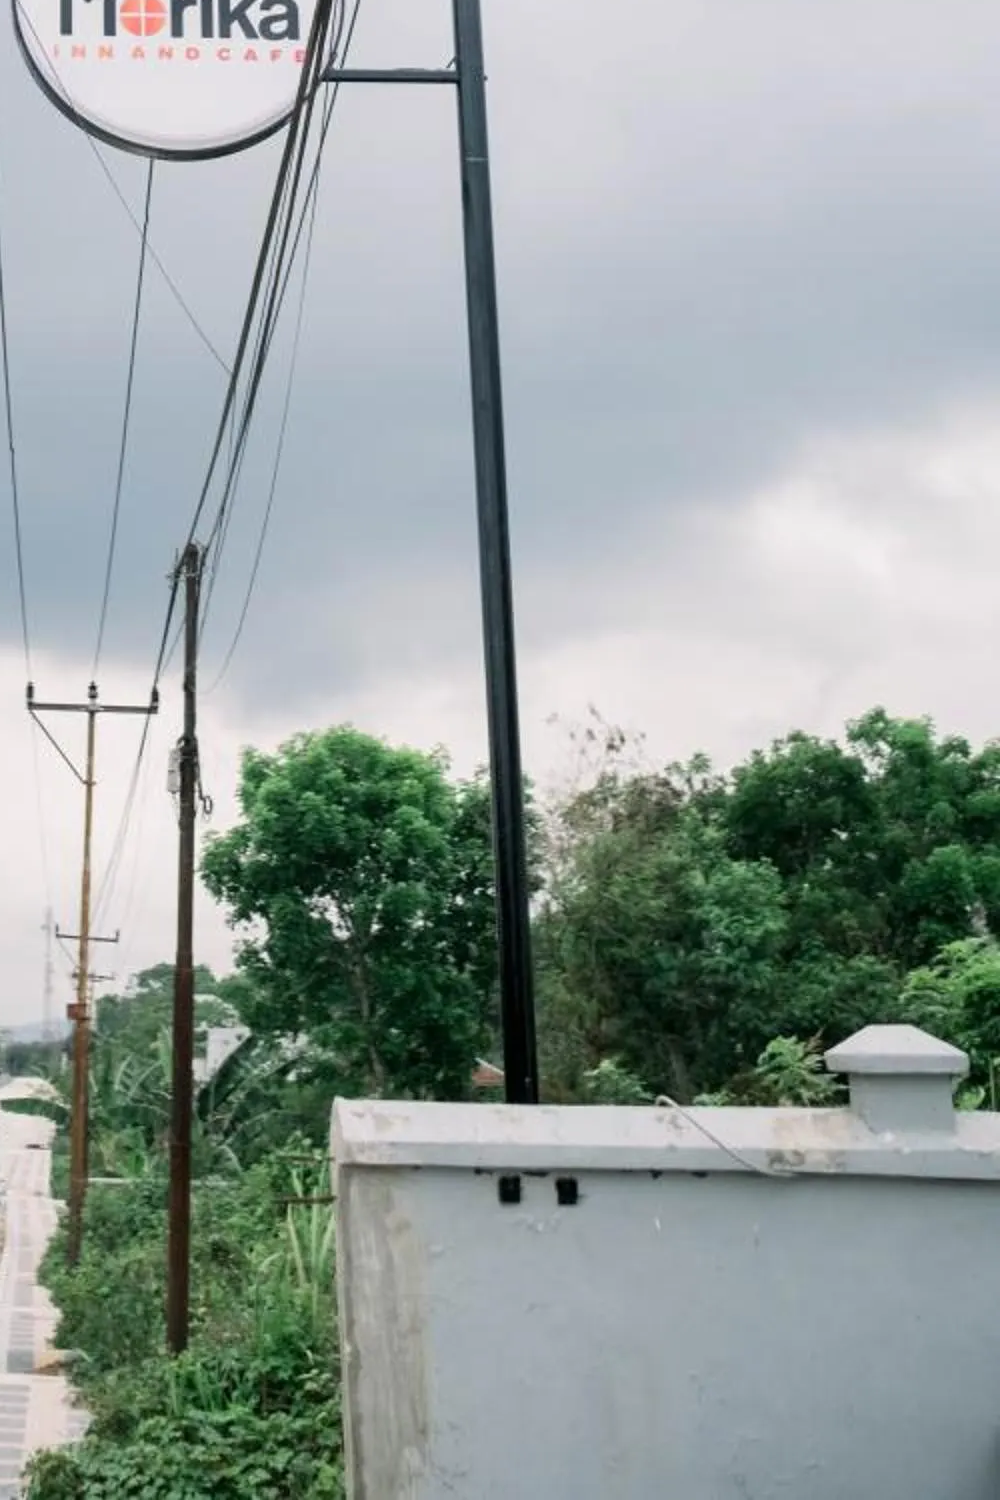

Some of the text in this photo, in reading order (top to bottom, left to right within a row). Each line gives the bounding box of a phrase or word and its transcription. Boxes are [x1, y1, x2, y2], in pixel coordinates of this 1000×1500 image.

[53, 43, 307, 62] INN AND CAFE
